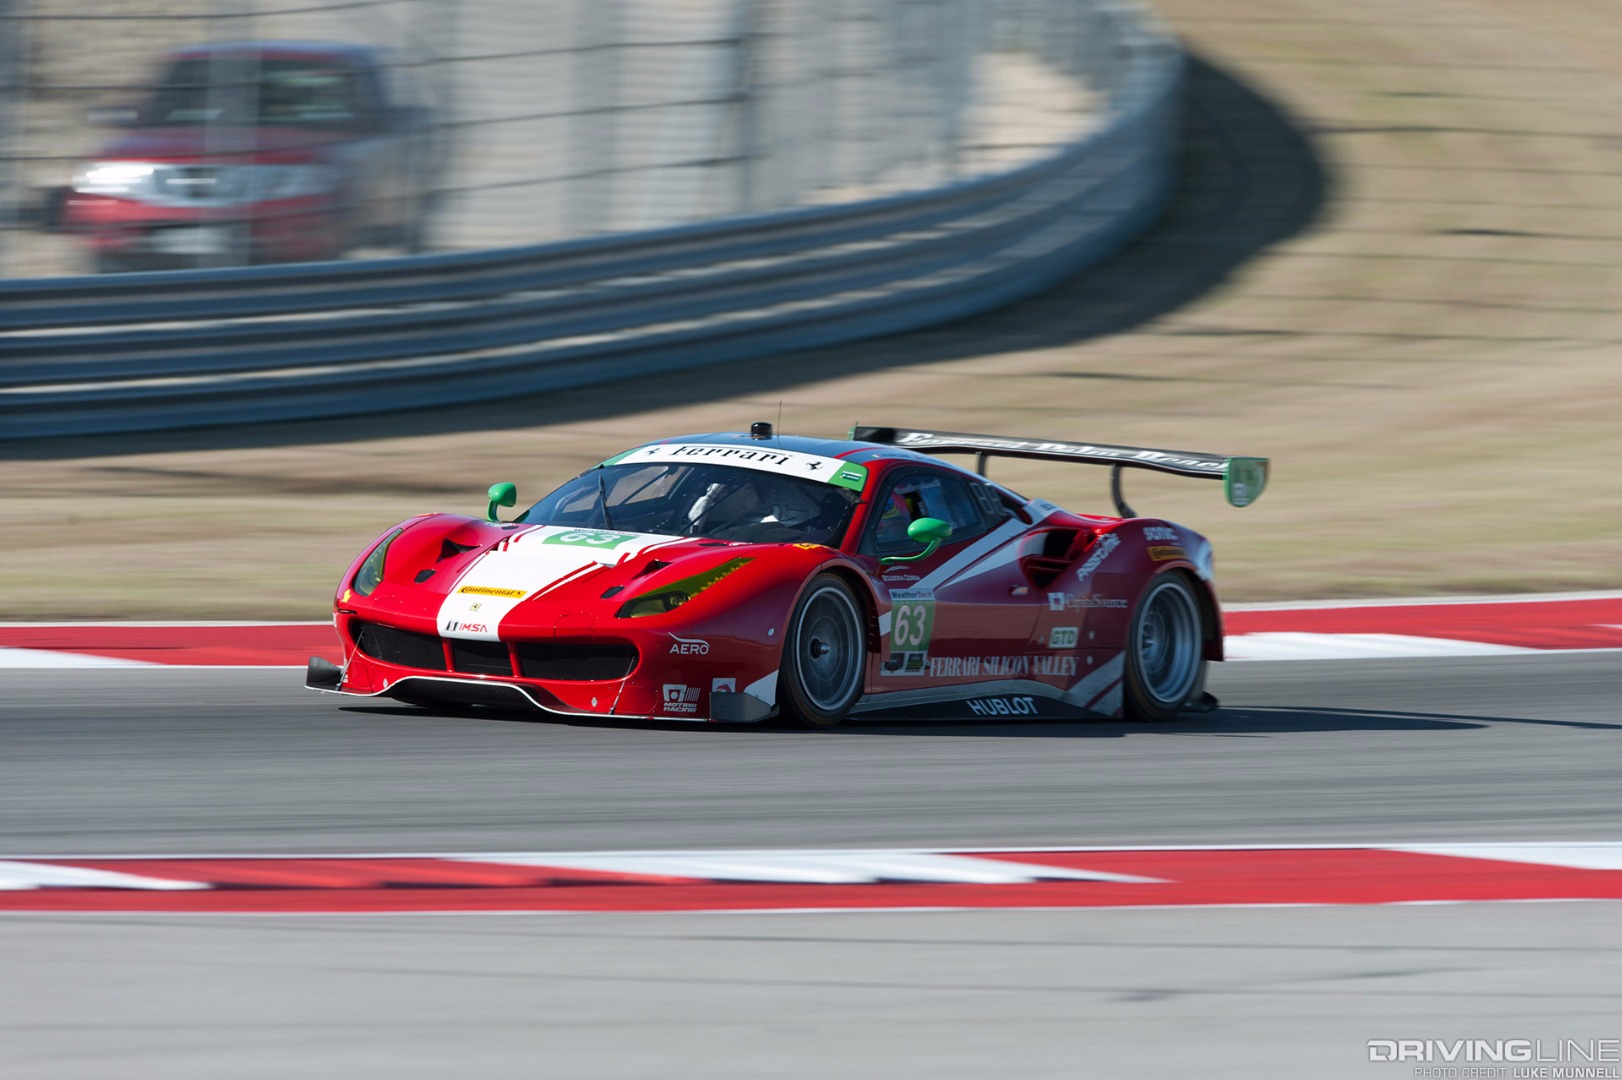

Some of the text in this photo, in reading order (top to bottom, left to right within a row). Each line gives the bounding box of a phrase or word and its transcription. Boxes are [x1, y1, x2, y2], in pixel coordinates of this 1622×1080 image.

[669, 445, 794, 466] Ferrari
[560, 532, 622, 545] 63
[461, 586, 515, 596] Continental
[891, 591, 932, 599] WeatherTech
[459, 622, 488, 632] IMSA
[894, 605, 927, 646] 63
[1052, 629, 1077, 645] GTD
[669, 643, 710, 655] AERO
[929, 656, 980, 677] FERRARI
[982, 655, 1029, 677] SILICON
[1030, 655, 1080, 676] VALLEY
[966, 697, 1039, 716] HUBLOT
